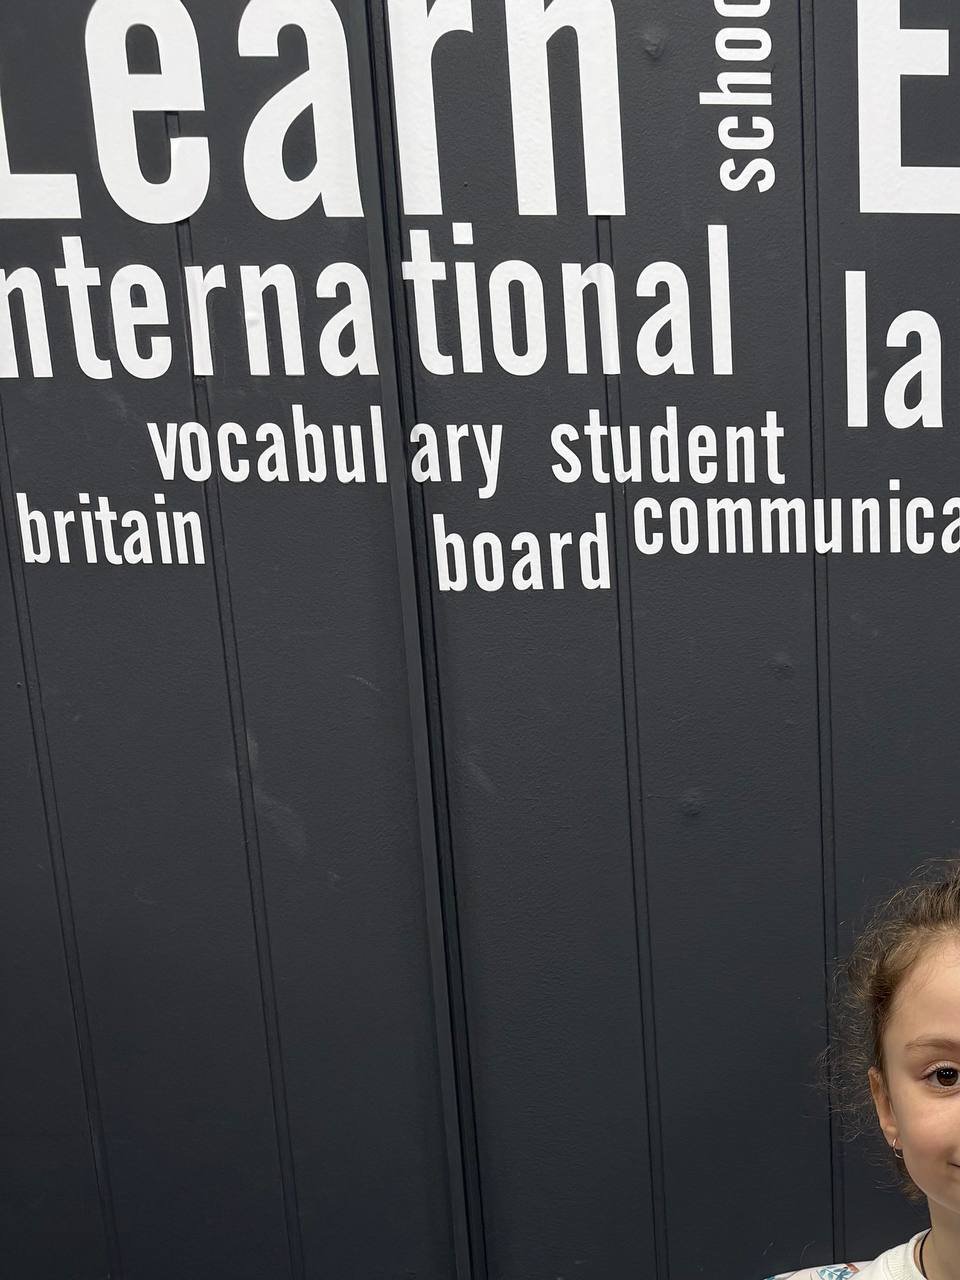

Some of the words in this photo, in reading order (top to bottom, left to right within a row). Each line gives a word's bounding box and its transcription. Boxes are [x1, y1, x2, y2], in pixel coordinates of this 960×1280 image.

[0, 0, 626, 224] earn
[551, 408, 786, 484] student
[16, 493, 205, 564] britain
[433, 513, 610, 591] board
